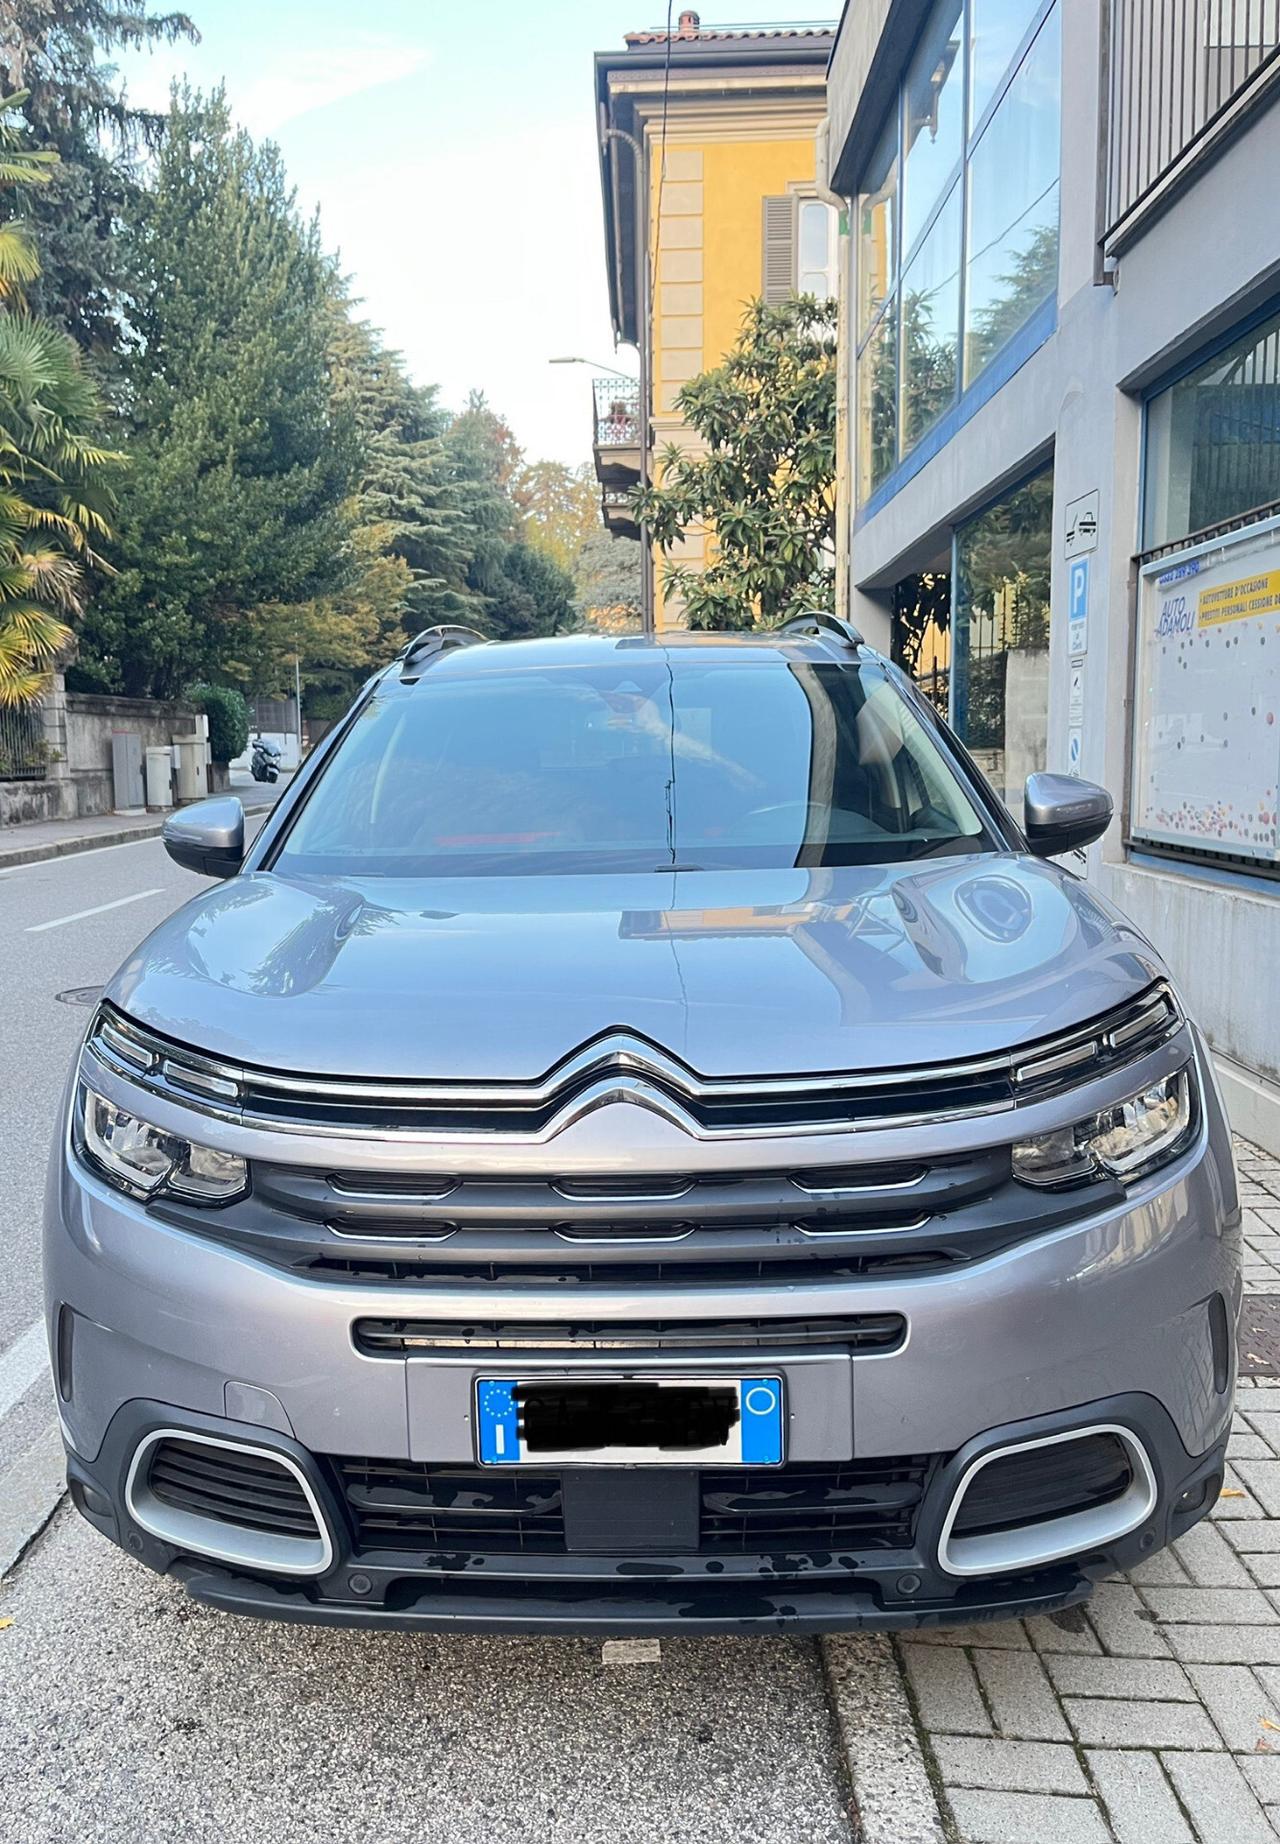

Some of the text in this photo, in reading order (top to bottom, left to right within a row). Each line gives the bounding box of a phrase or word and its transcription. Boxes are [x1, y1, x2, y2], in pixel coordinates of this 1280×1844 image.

[1074, 568, 1084, 614] P
[1203, 578, 1268, 605] AUTOVETTURE D'OCCASIONE
[1163, 596, 1185, 617] AUTO
[1222, 602, 1247, 617] PERSONALI
[1249, 595, 1273, 611] CESSIONE
